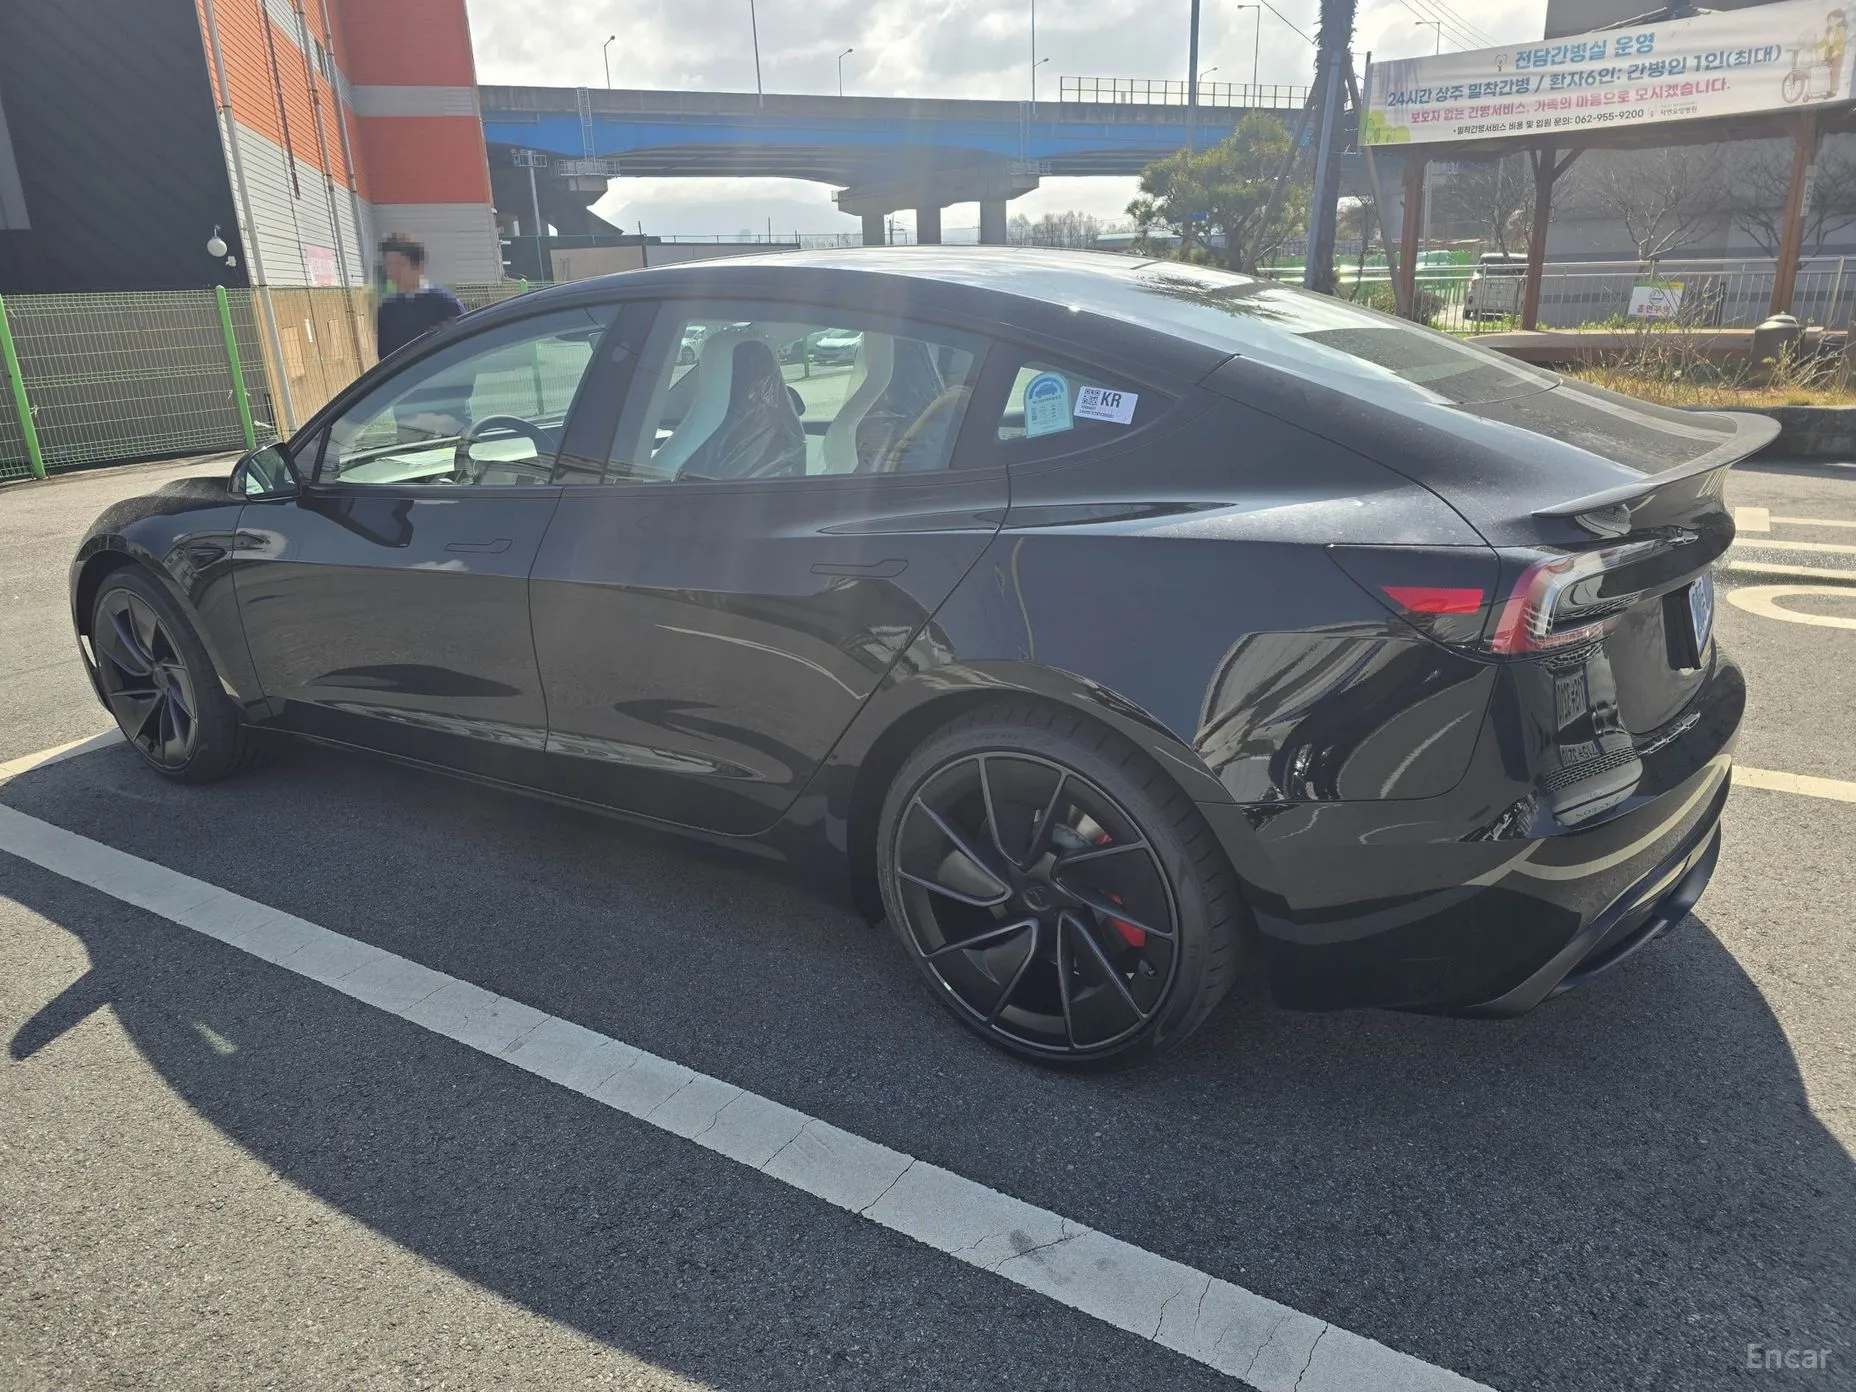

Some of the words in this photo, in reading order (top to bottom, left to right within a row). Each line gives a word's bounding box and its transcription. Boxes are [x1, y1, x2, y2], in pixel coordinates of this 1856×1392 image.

[1515, 40, 1607, 69] 전담간병실
[1614, 32, 1655, 57] 운영
[1388, 88, 1432, 107] 24시간
[1435, 85, 1463, 102] 상주
[1468, 77, 1530, 99] 밀착간병
[1549, 67, 1623, 91] 환자6인:
[1627, 57, 1687, 81] 간병인
[1694, 44, 1782, 72] 1인(최대)
[1444, 107, 1464, 121] 없는
[1534, 95, 1572, 112] 가족의
[1635, 77, 1731, 102] 모시겠습니다.
[1575, 109, 1644, 124] 062-955-9200
[1100, 390, 1122, 408] KR
